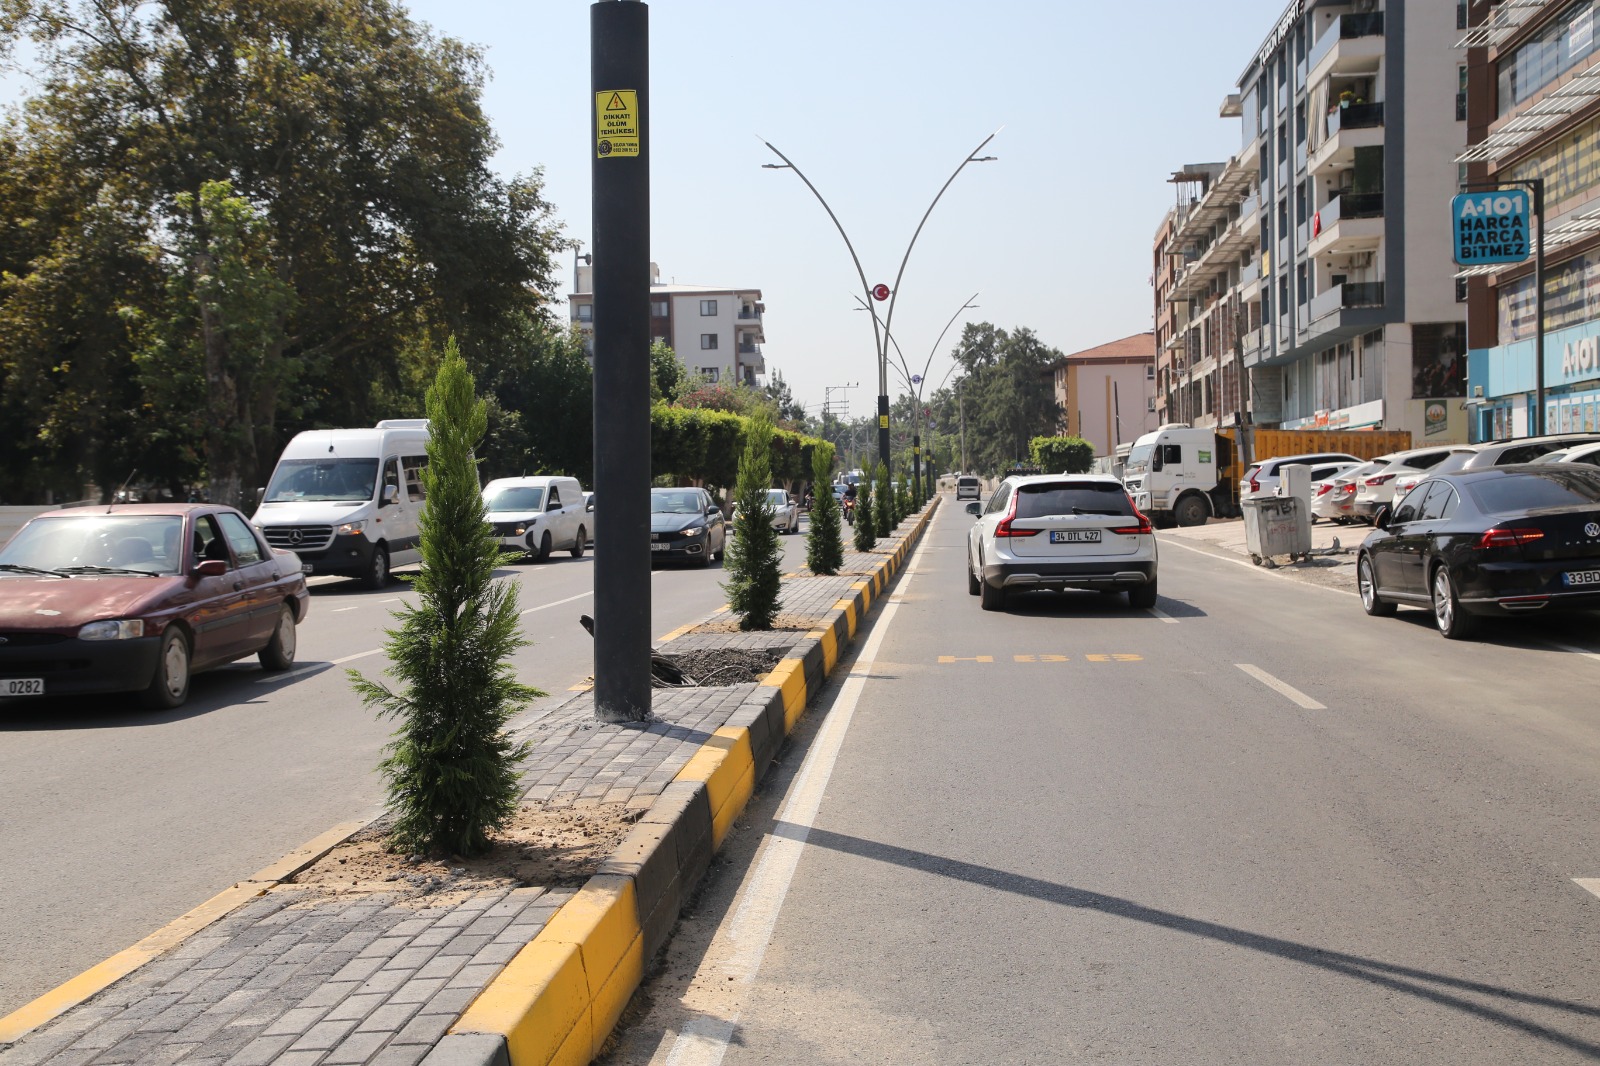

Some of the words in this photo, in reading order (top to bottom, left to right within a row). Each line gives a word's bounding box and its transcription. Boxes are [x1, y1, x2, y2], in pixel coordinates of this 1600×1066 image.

[607, 120, 627, 128] ÖLÜM
[1460, 215, 1523, 231] HARCA
[1460, 229, 1524, 245] HARCA
[1055, 532, 1065, 541] 34
[1067, 532, 1082, 540] DTL
[1084, 531, 1099, 540] 427
[9, 680, 41, 694] 0282
